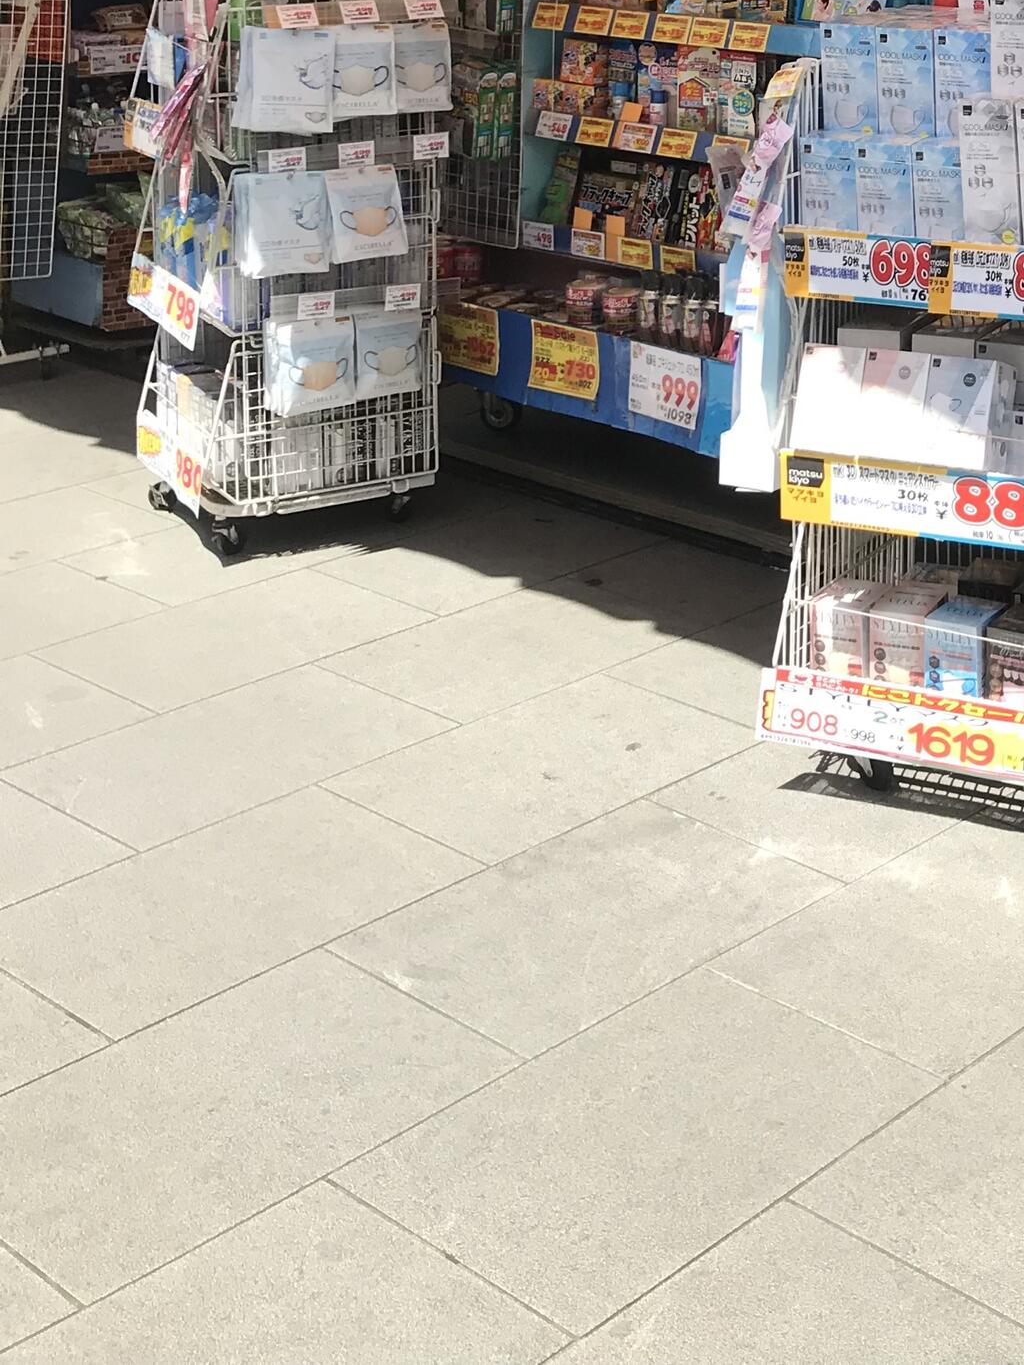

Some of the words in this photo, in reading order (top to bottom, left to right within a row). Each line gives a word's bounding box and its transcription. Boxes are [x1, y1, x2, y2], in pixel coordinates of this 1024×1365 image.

[870, 239, 932, 287] 698
[911, 289, 929, 302] 76
[167, 283, 195, 330] 798
[565, 360, 596, 380] 730
[661, 373, 699, 411] 999
[788, 469, 823, 478] matsu
[788, 474, 810, 485] kiyo
[897, 490, 929, 502] 30枚
[789, 708, 838, 736] 908
[850, 729, 876, 743] 998
[908, 722, 995, 767] 1619
